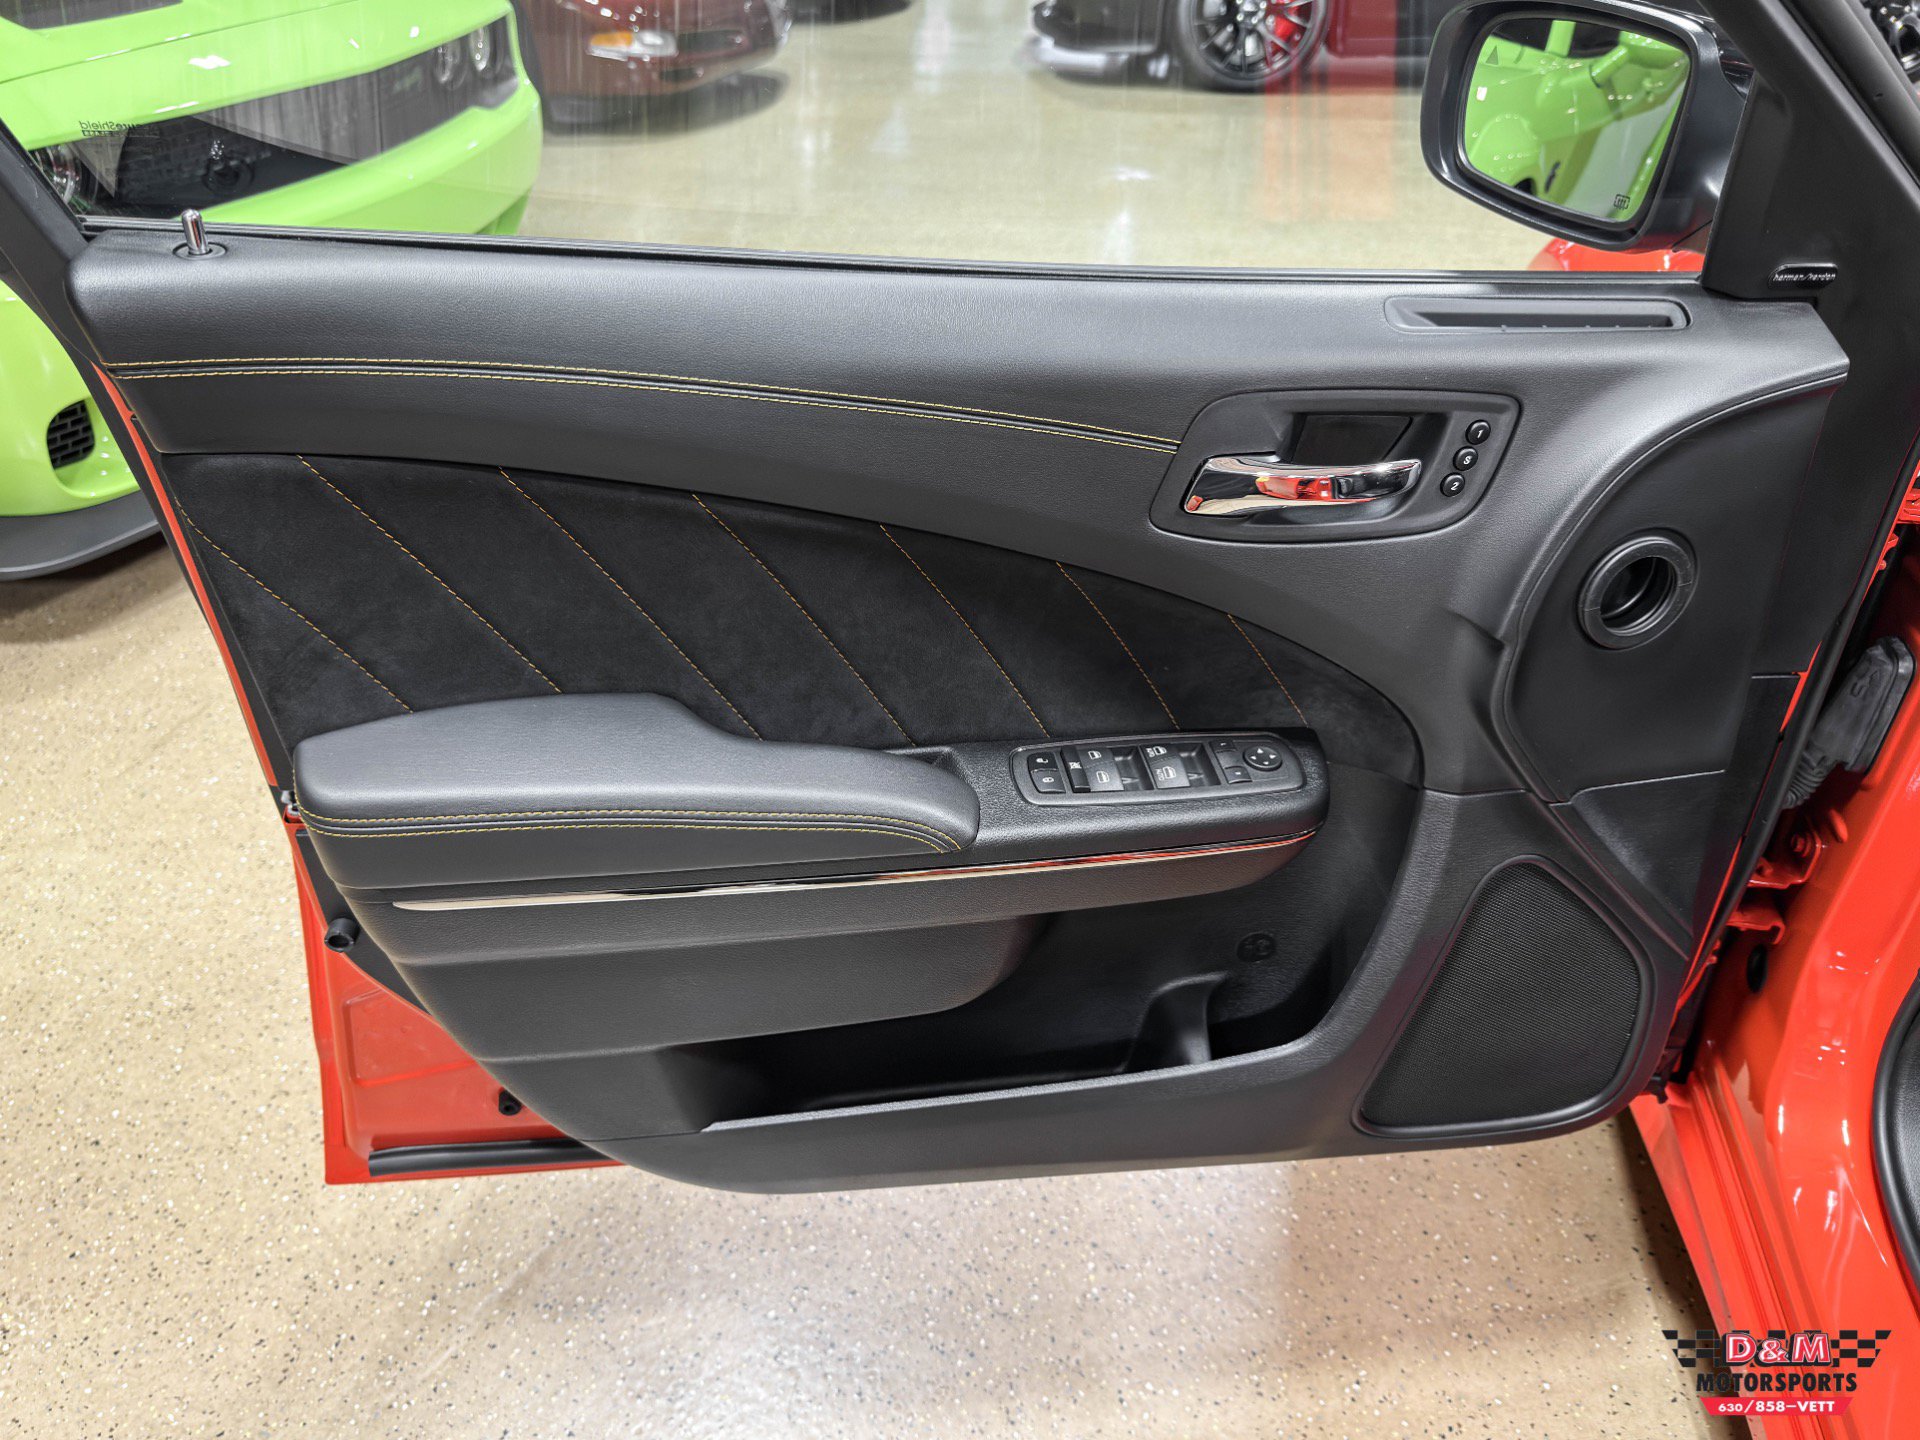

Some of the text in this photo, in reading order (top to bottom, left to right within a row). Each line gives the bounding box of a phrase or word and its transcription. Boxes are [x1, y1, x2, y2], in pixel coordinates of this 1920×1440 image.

[1477, 430, 1484, 438] 1
[1463, 455, 1473, 465] S
[1450, 481, 1460, 491] 2
